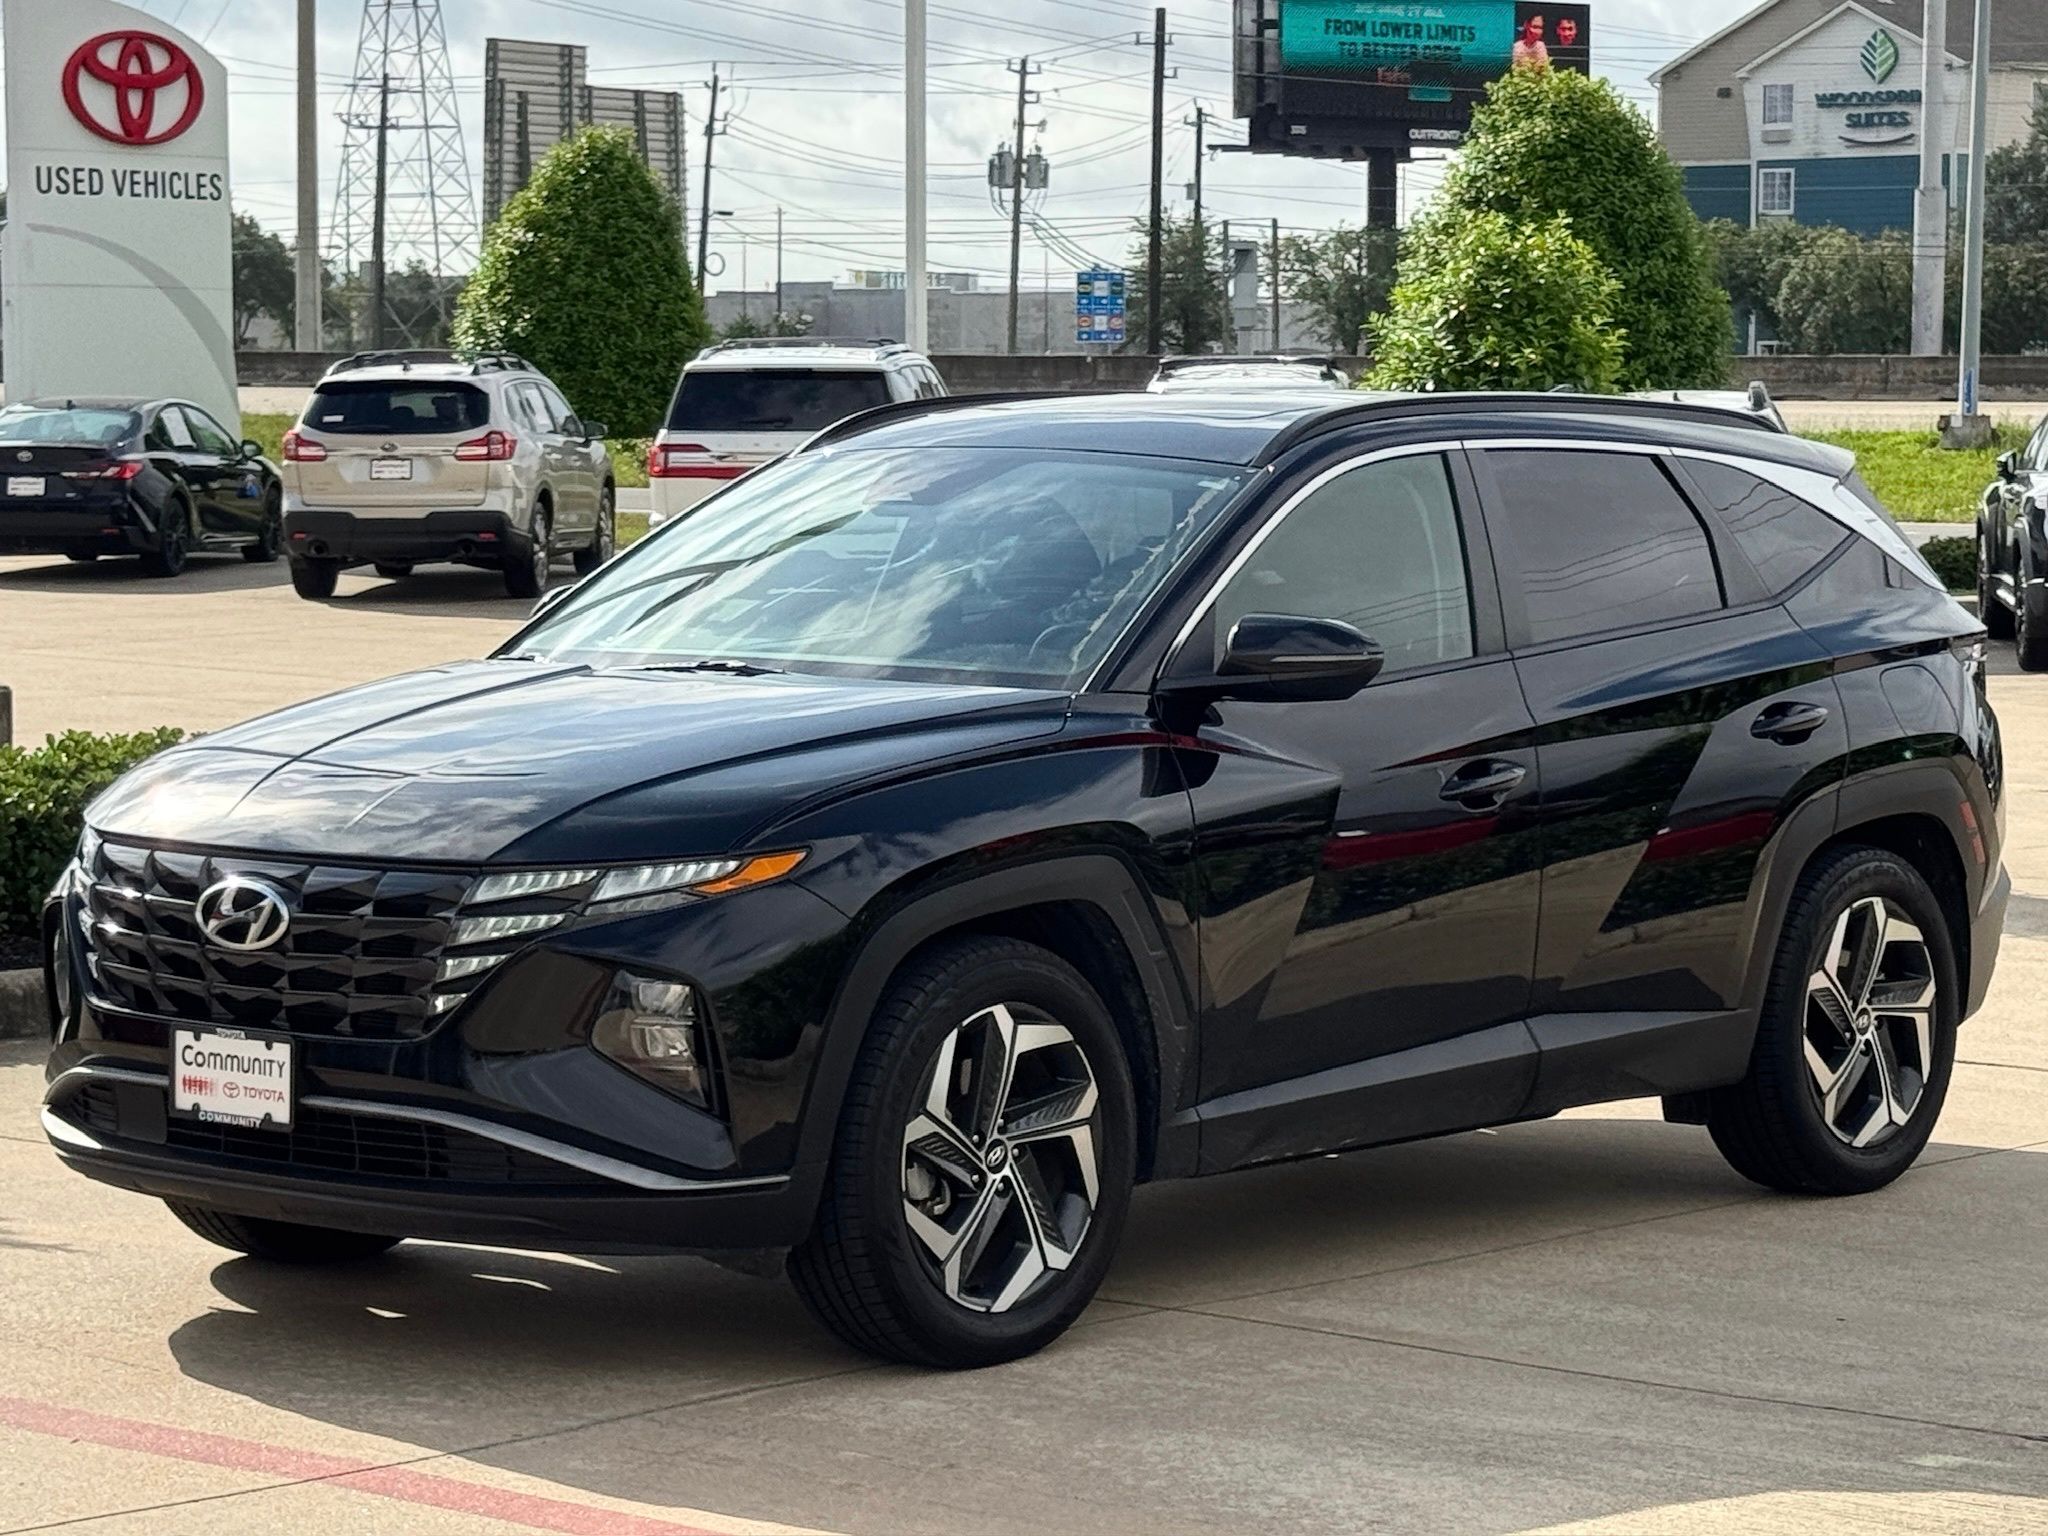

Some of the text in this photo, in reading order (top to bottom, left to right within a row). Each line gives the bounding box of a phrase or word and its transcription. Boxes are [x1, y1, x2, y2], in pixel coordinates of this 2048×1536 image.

[1324, 19, 1476, 42] FROM LOWER LIMITS
[1845, 111, 1912, 127] SUITES
[35, 165, 223, 201] USED VEHICLES
[243, 1085, 285, 1103] TOYOTA
[198, 1111, 262, 1128] COMMUNITY
